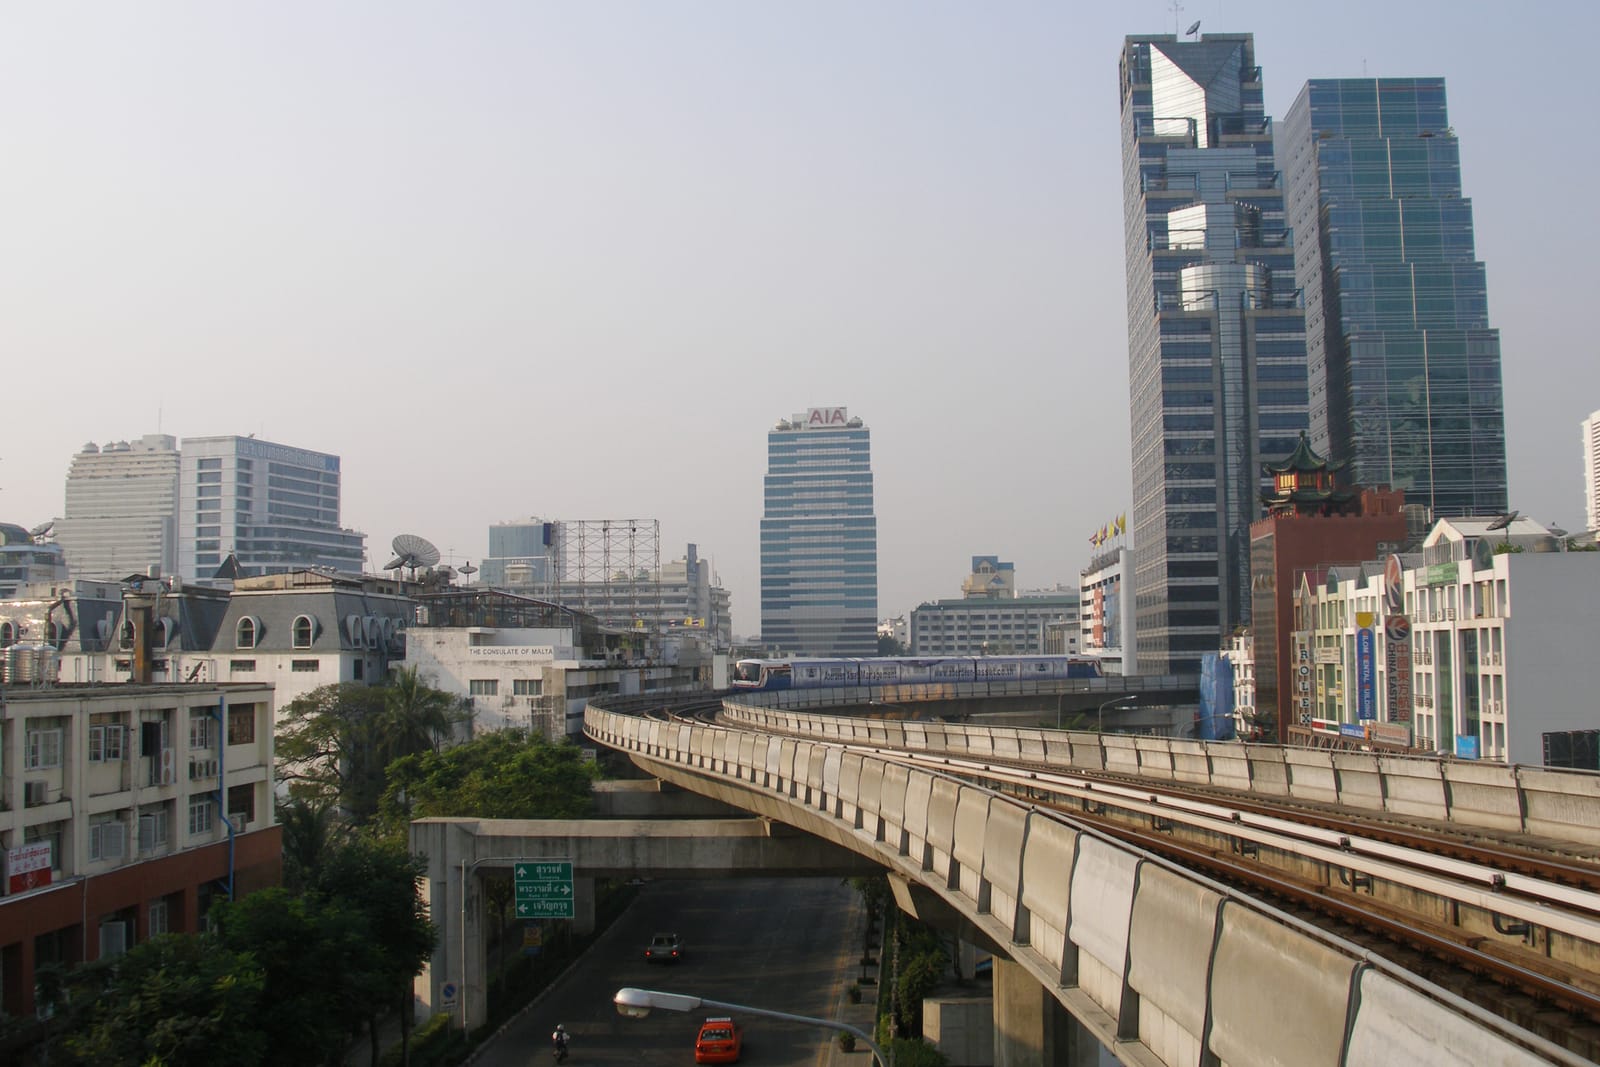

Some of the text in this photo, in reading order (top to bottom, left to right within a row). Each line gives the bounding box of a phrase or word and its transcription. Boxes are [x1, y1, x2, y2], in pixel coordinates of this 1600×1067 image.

[809, 410, 845, 424] AIA
[1300, 650, 1311, 723] ROLEX
[1388, 642, 1398, 722] CHINA EASTERN
